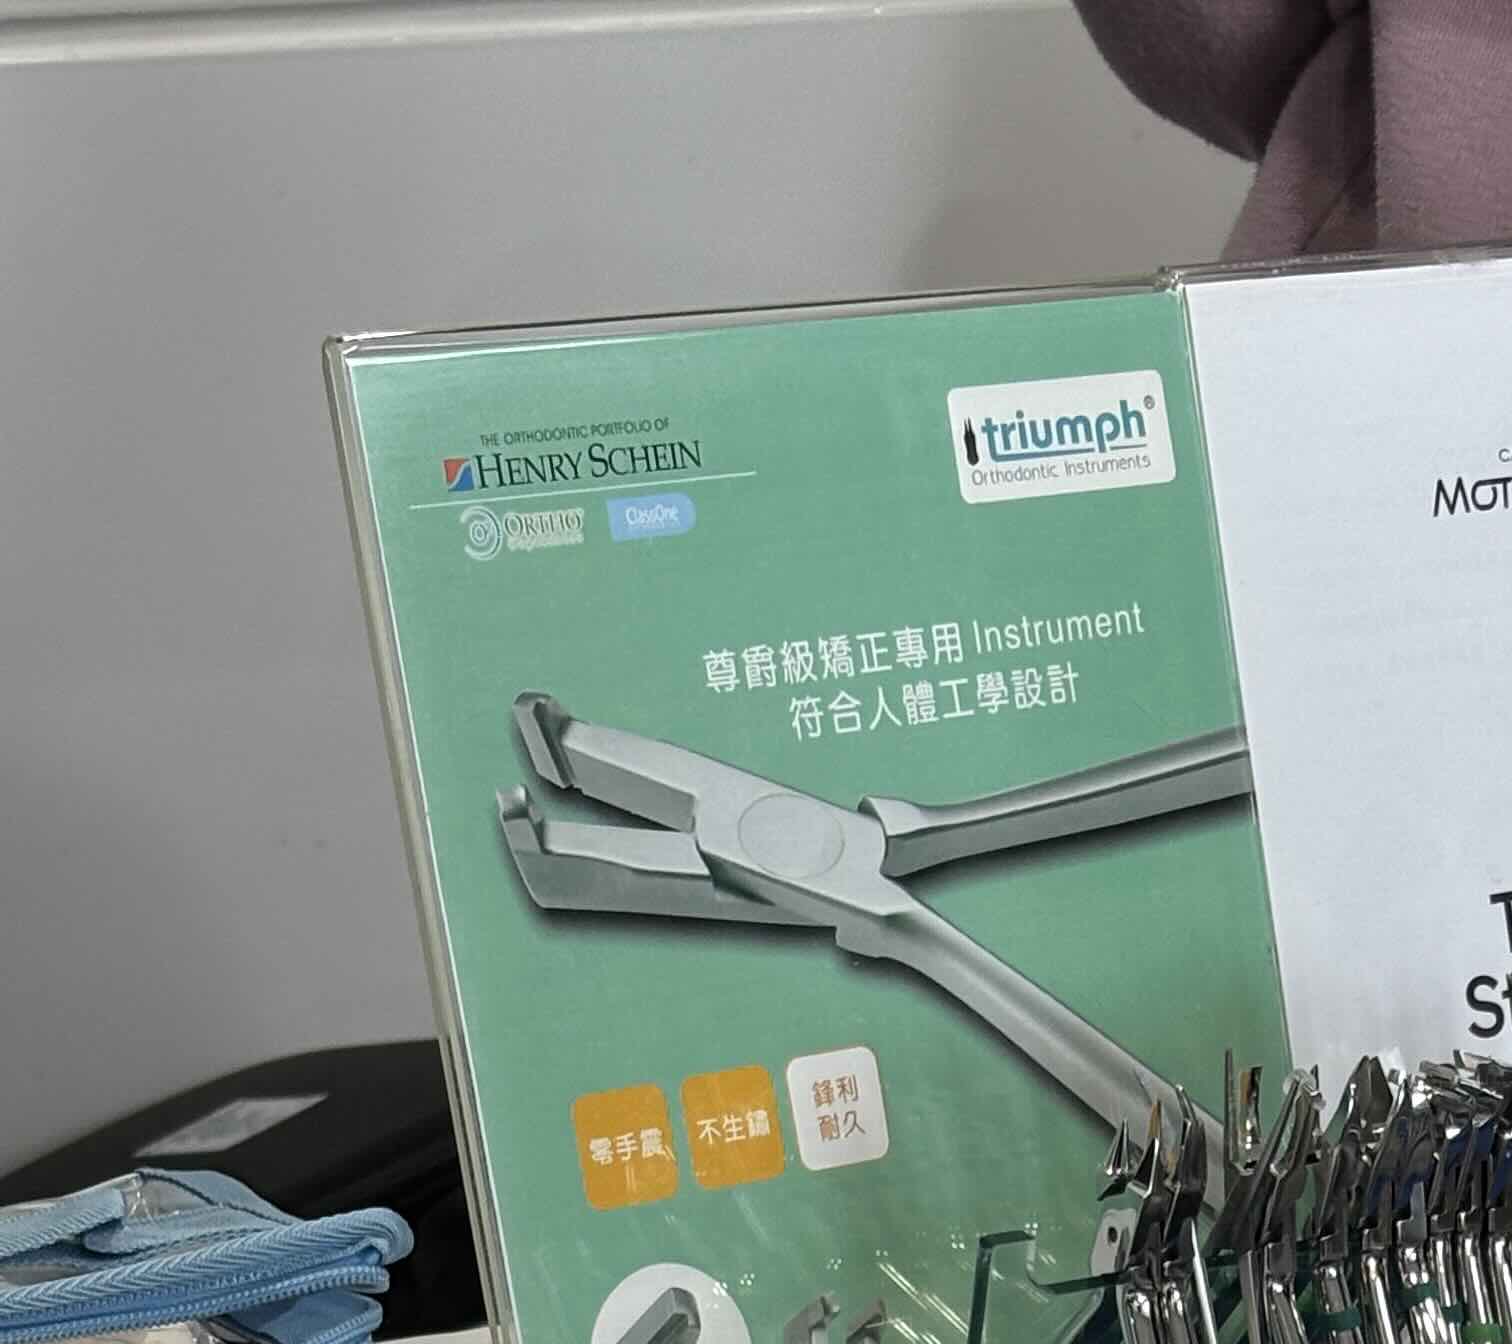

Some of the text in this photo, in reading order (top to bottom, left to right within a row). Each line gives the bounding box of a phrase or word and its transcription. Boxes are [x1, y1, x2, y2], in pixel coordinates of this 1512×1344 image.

[480, 417, 670, 447] THE ORTHODONTIC PORTFOLIO OF
[475, 440, 702, 489] HENRY SCHEIN
[971, 453, 1151, 487] Orthodontic Instruments
[703, 604, 1145, 691] 尊爵級矯正專用 Instrument
[790, 661, 1079, 740] 符合人體工學設計
[817, 1110, 865, 1142] 耐久
